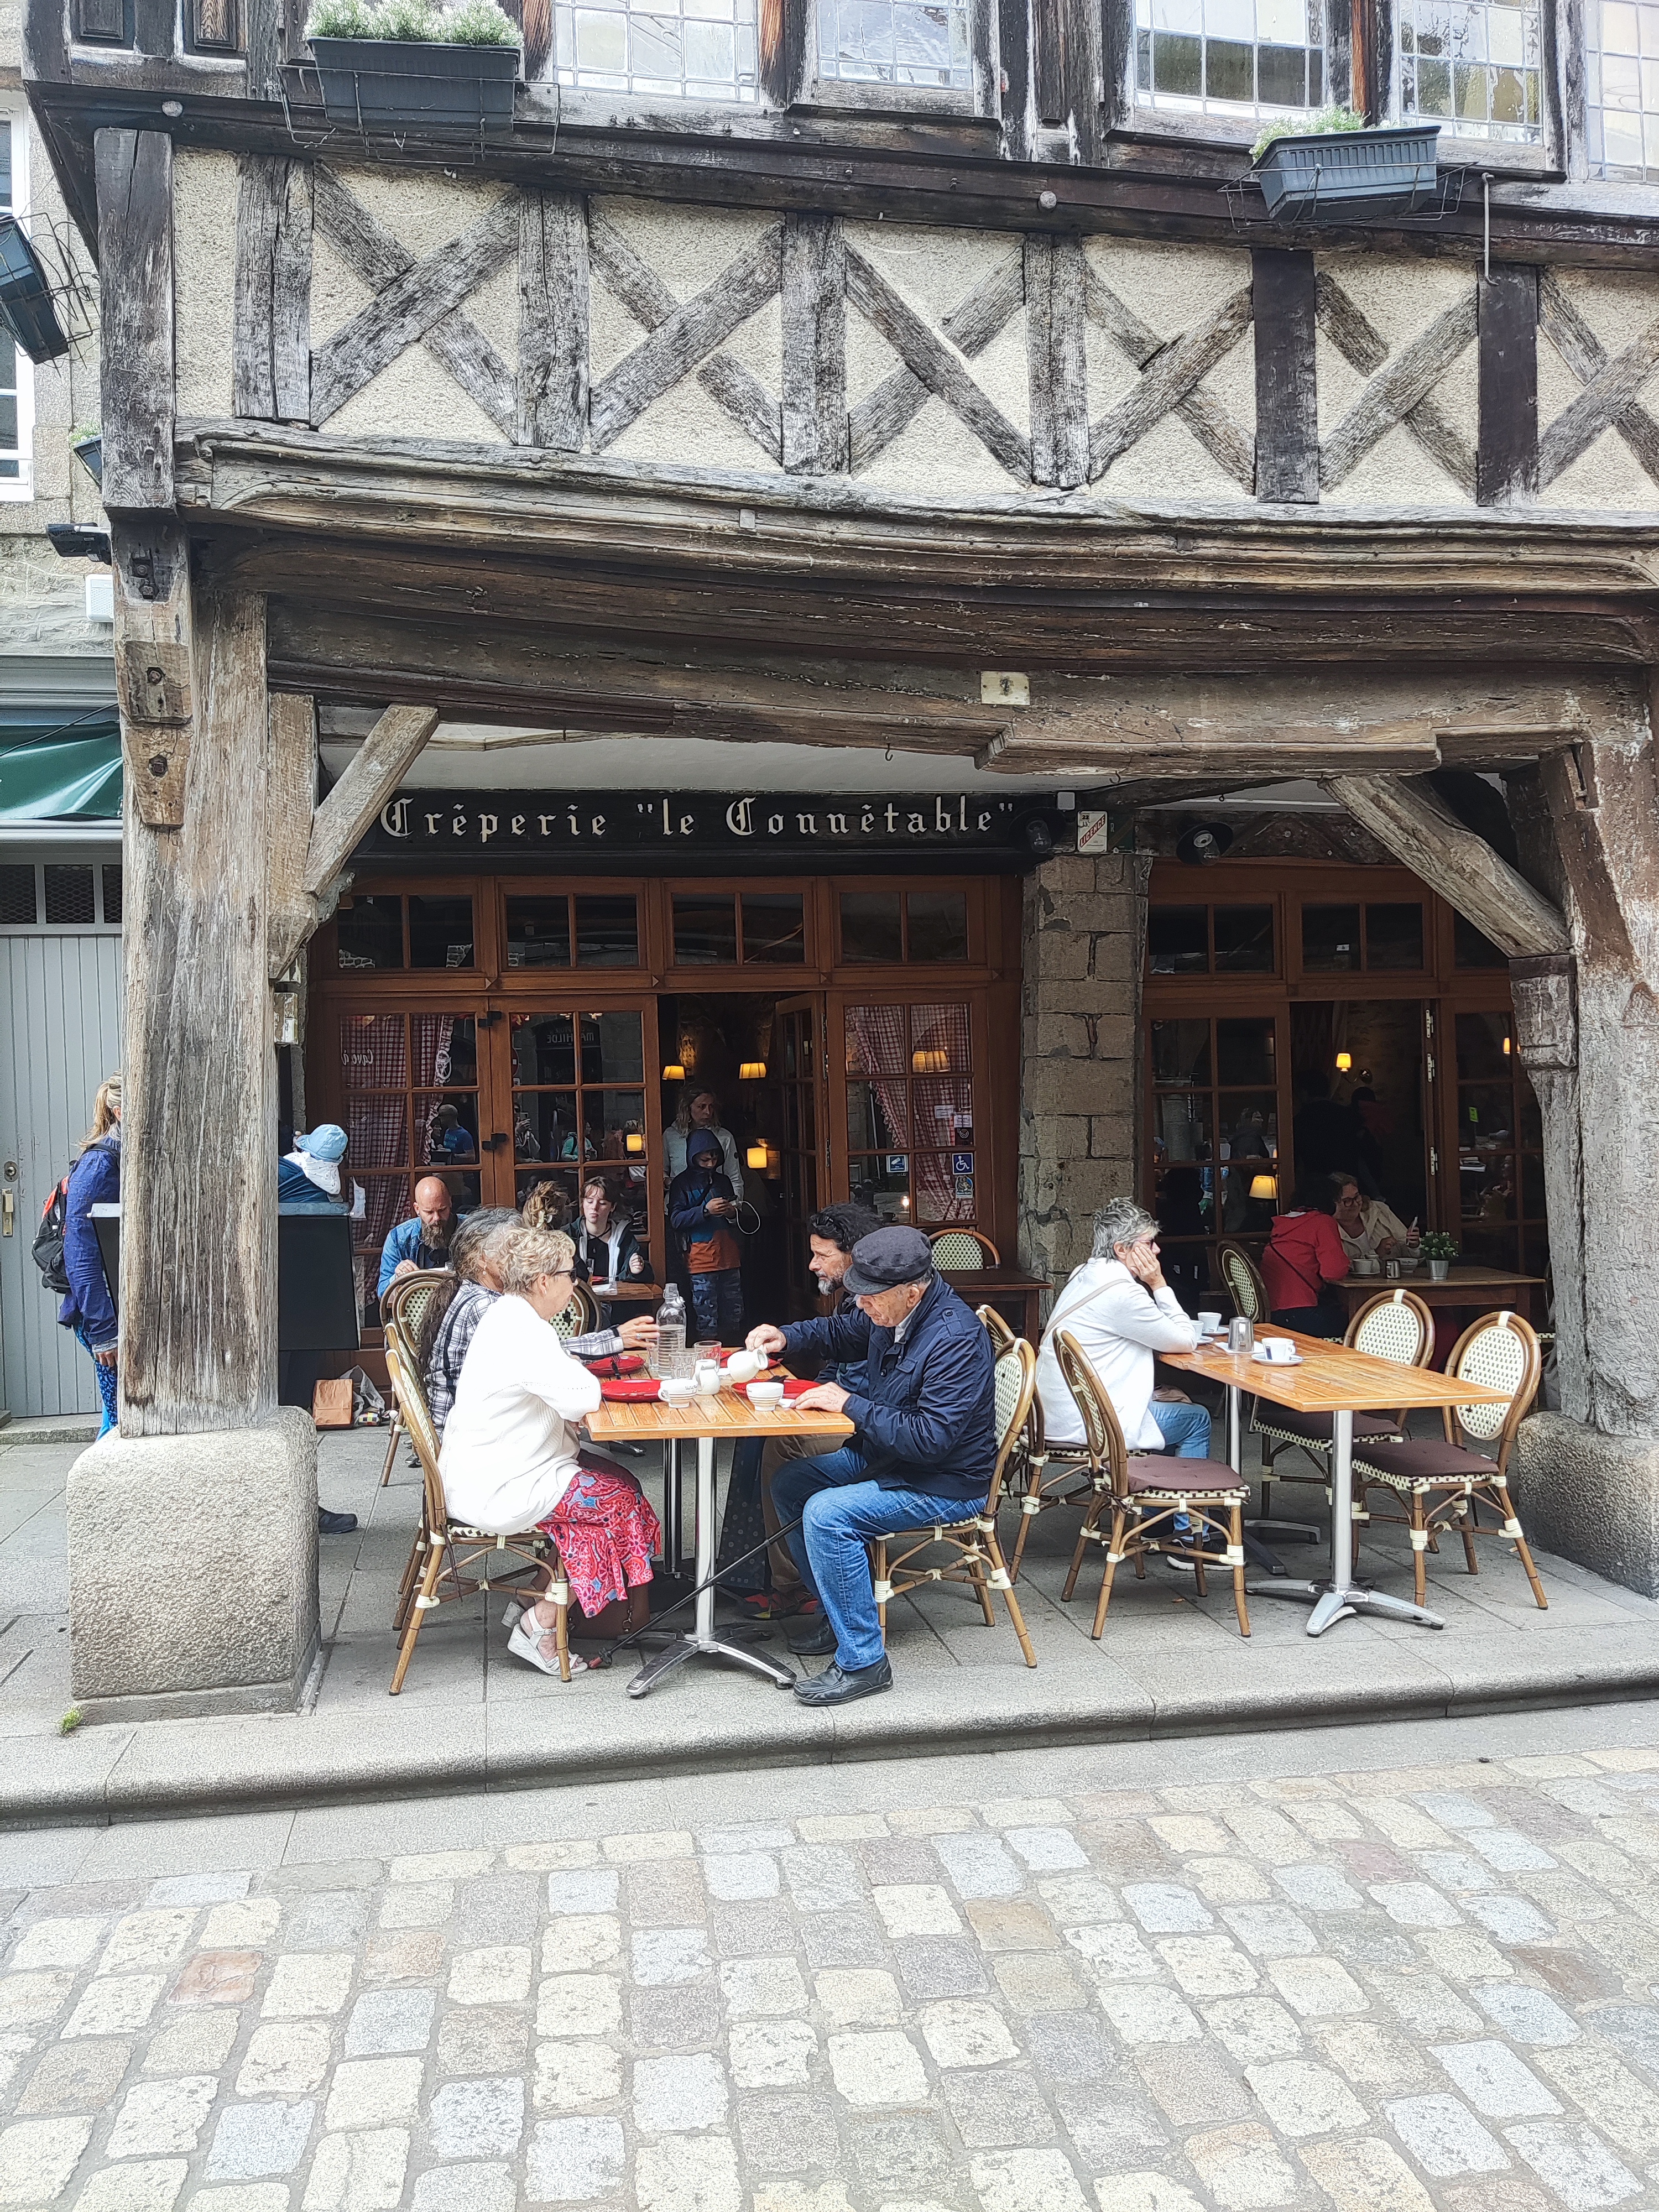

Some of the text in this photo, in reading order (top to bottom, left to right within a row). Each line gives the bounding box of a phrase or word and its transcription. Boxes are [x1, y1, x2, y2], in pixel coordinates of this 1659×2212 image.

[380, 795, 1014, 843] Crêperie "le Connêtable"
[1081, 816, 1105, 847] LICENCE
